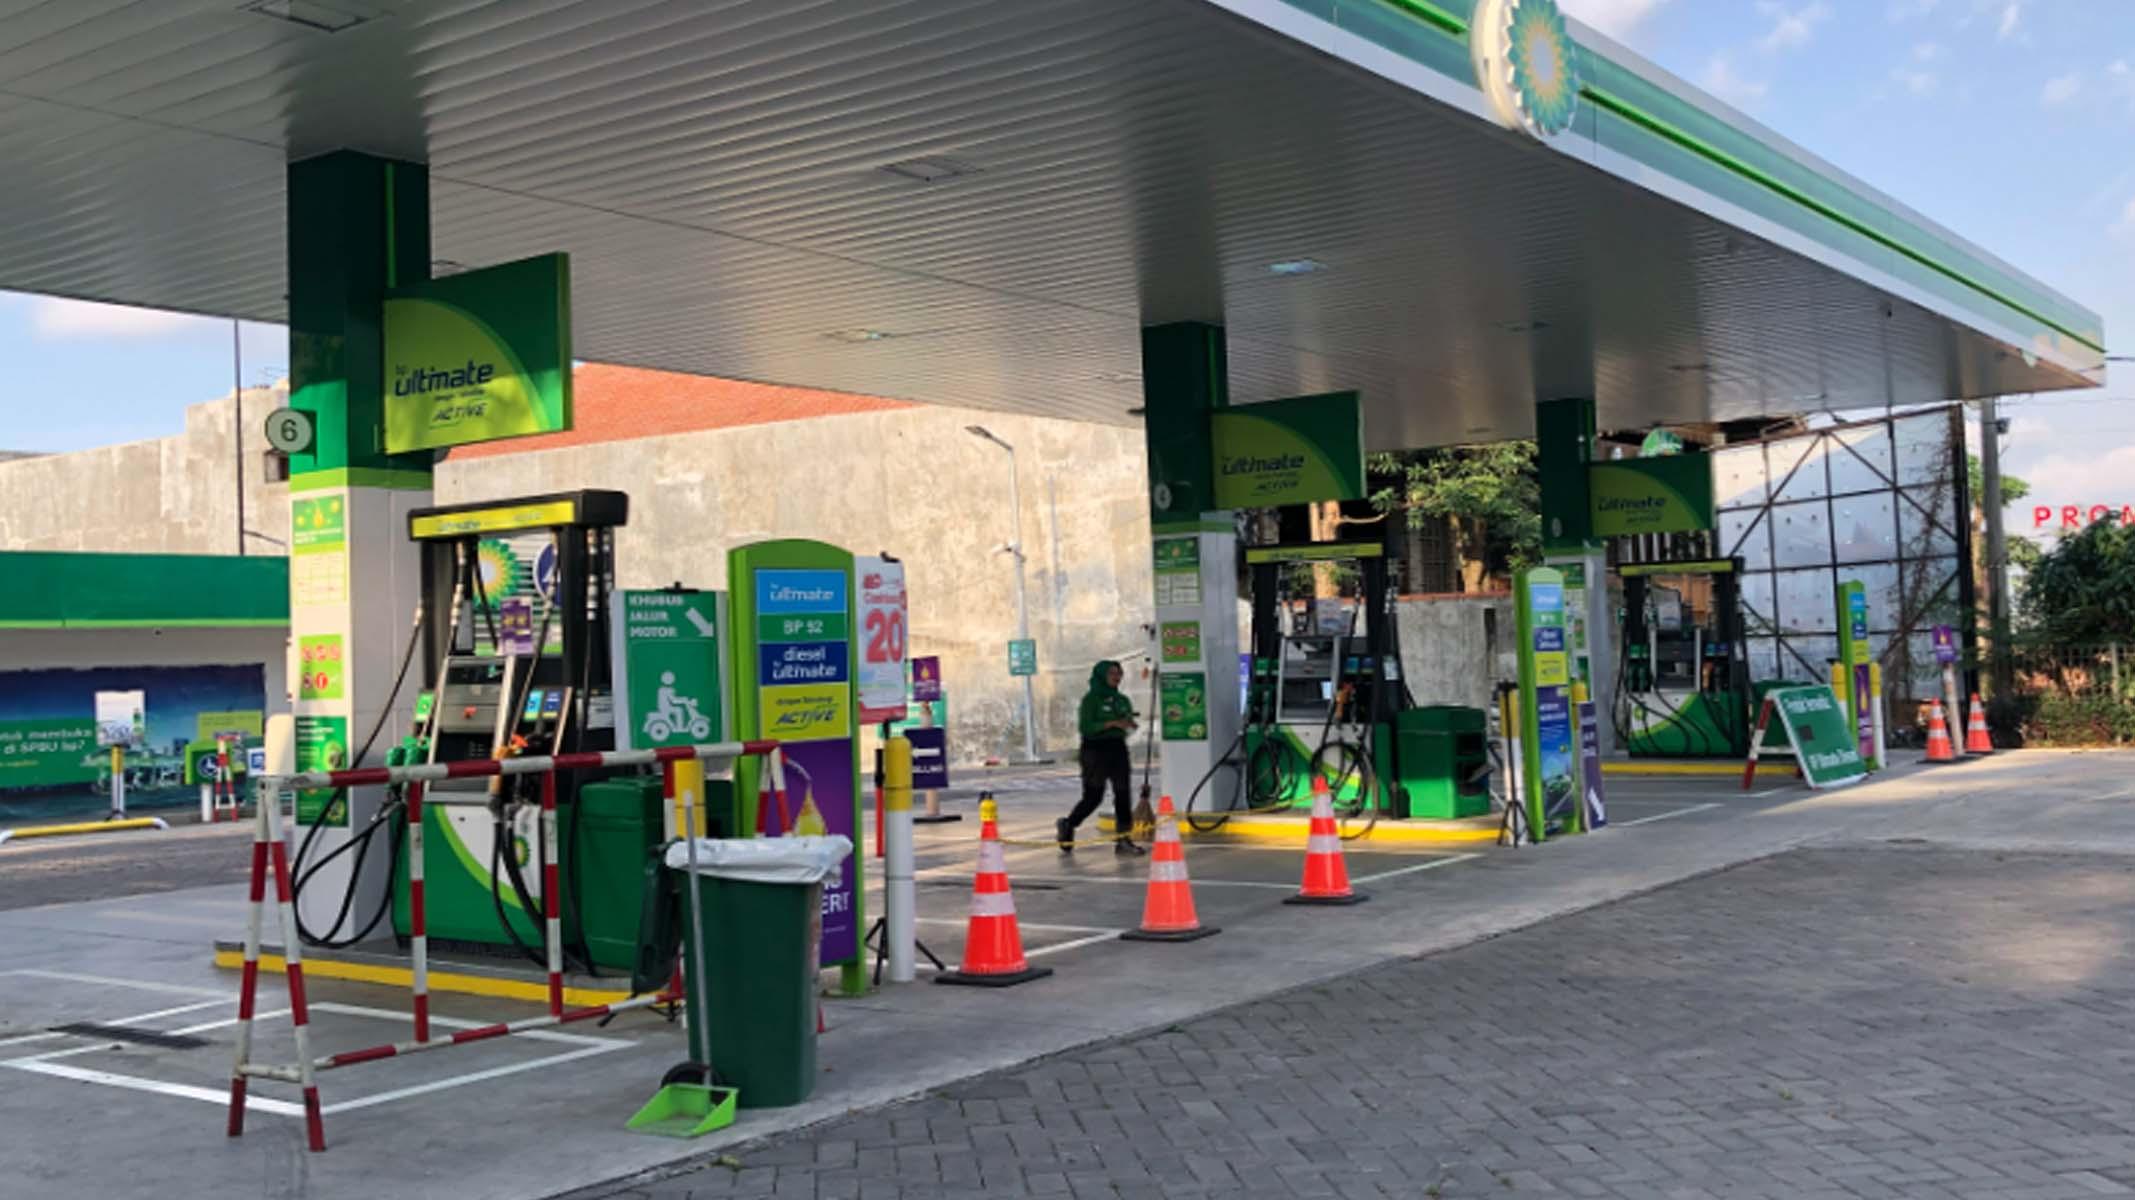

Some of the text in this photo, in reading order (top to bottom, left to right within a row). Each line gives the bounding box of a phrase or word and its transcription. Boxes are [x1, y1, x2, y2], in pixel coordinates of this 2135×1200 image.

[395, 359, 495, 397] ultimate
[280, 418, 298, 442] 6
[1222, 453, 1305, 476] ultimate
[770, 586, 835, 602] ultimate
[629, 626, 678, 638] MOTOR
[783, 646, 827, 662] diesel
[772, 663, 838, 680] ultimate
[776, 709, 838, 725] ACTIVE
